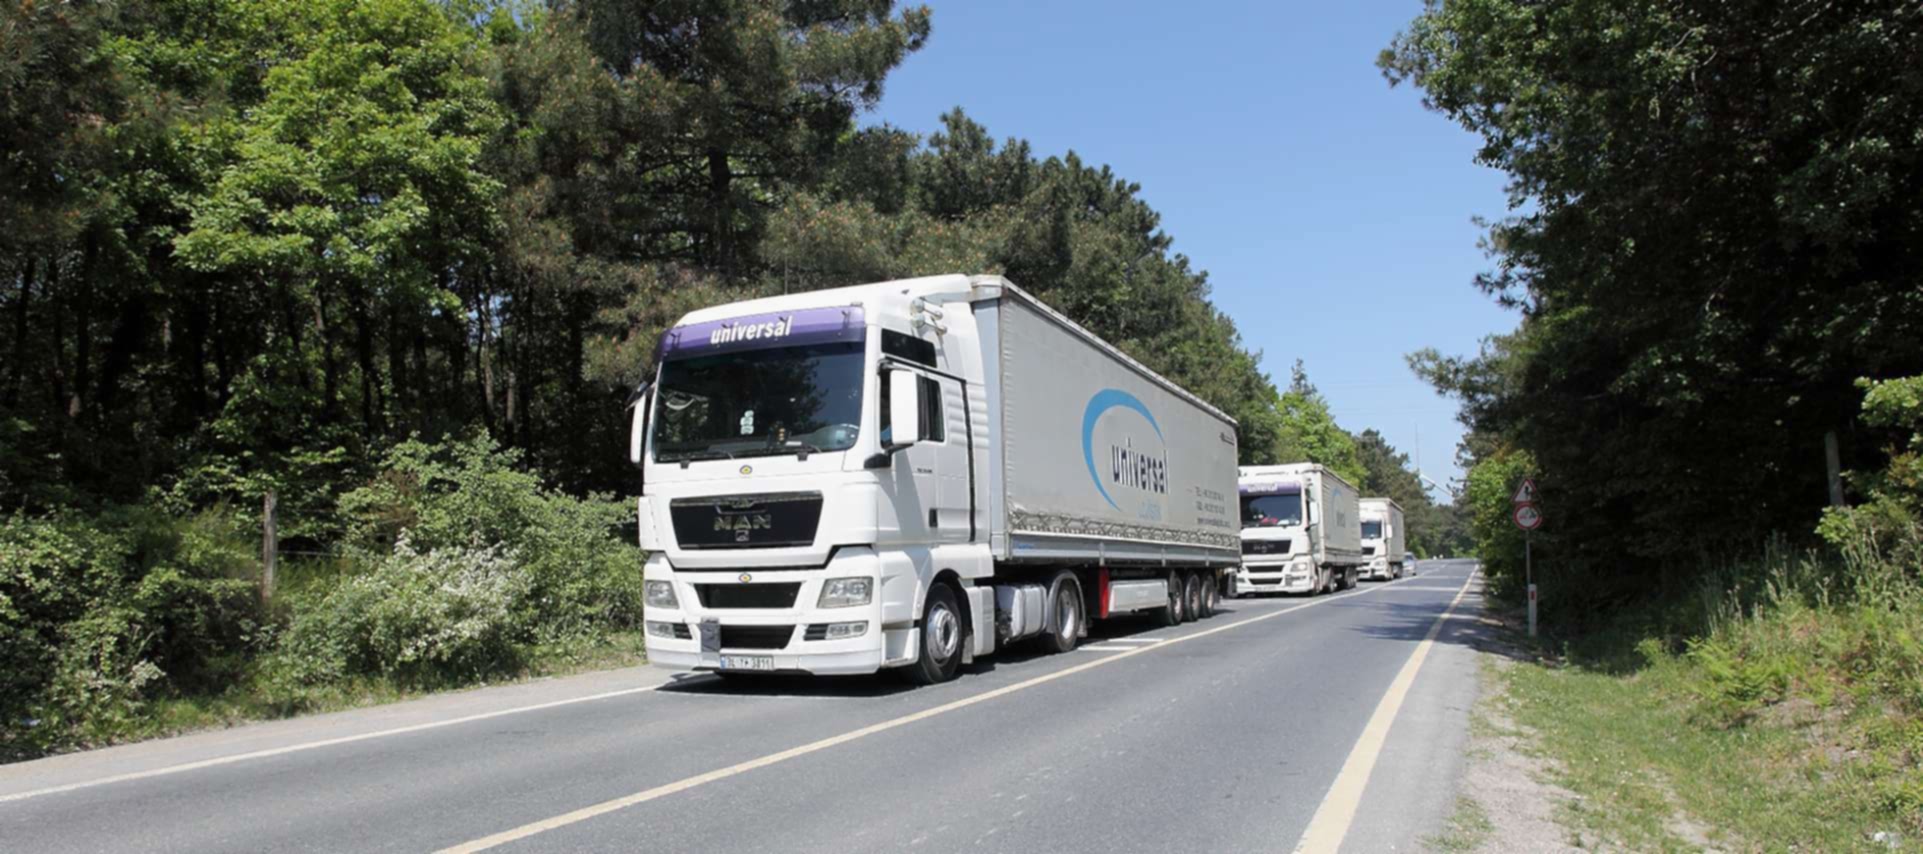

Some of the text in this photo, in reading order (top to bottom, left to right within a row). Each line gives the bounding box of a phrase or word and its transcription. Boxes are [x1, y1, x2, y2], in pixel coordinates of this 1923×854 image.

[710, 315, 793, 345] universal
[1111, 436, 1169, 495] universal
[713, 514, 772, 531] MAN
